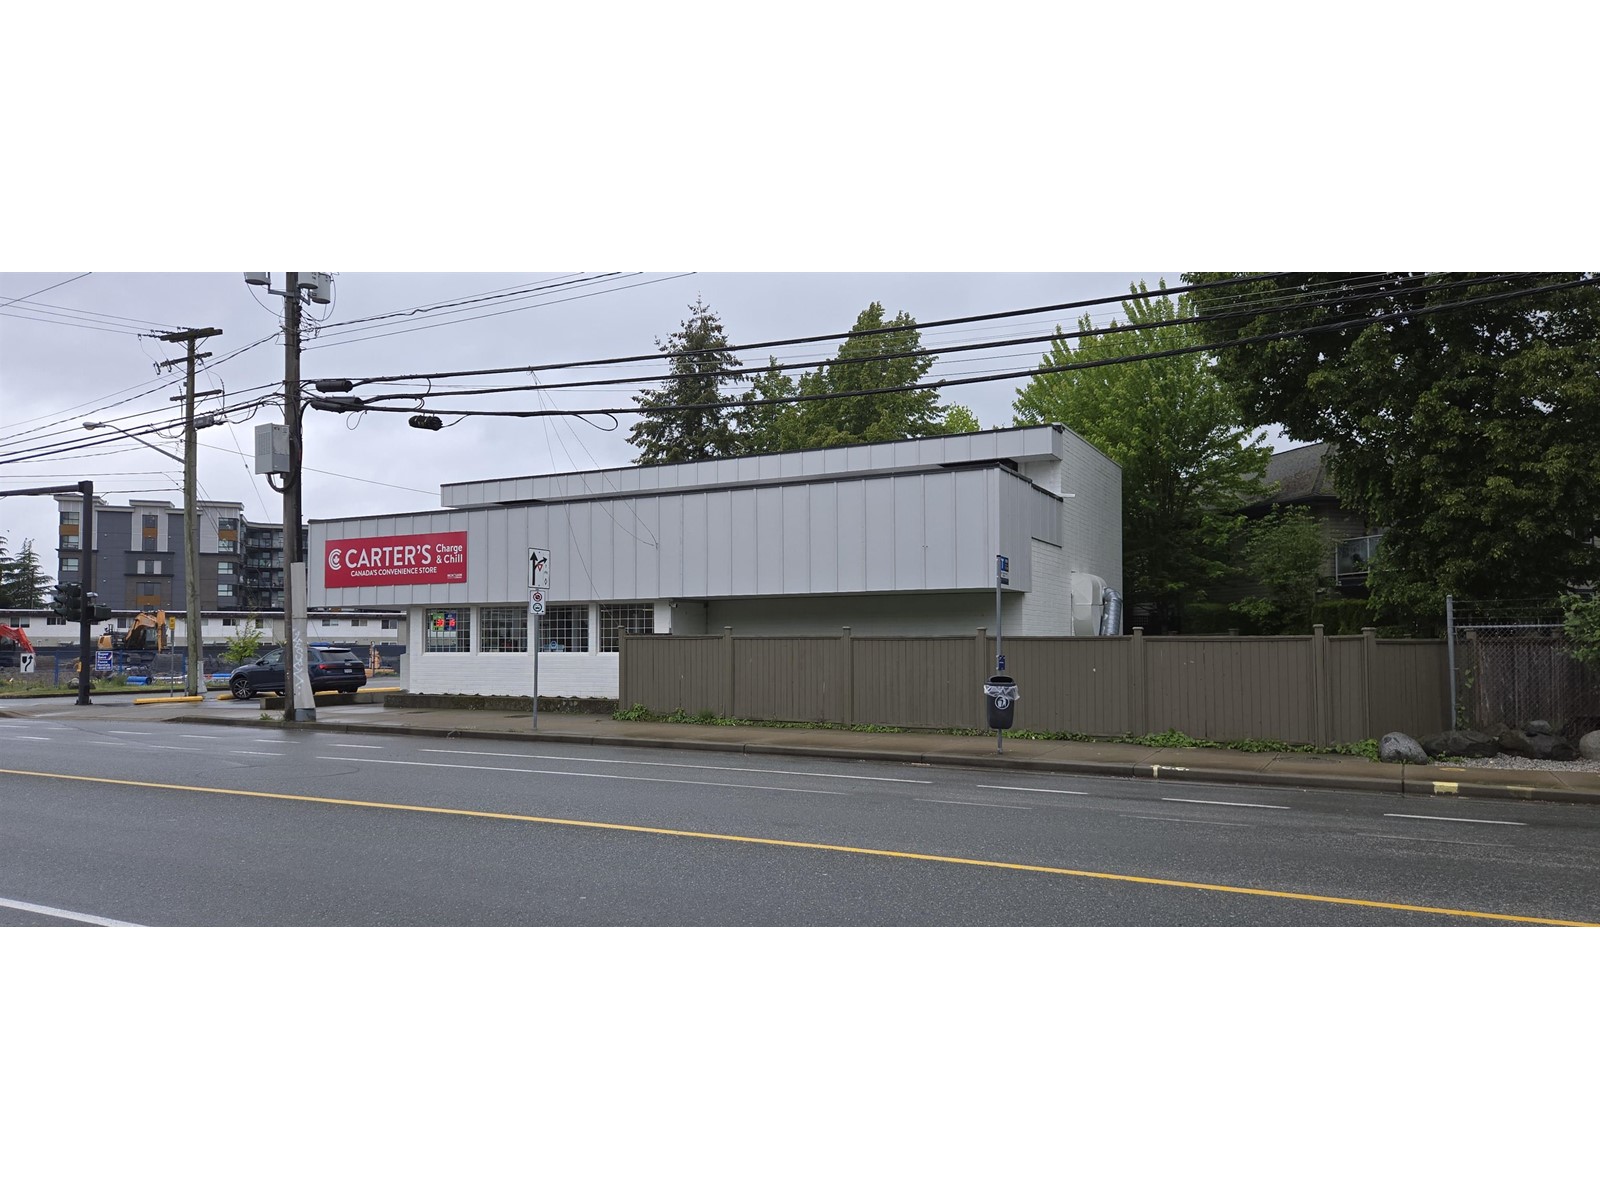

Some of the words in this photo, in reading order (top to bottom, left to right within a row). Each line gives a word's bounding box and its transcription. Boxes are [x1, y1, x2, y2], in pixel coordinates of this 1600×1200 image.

[435, 543, 463, 554] Charge
[345, 544, 432, 568] CARTER'S
[436, 555, 442, 564] &
[443, 554, 463, 564] Chill
[350, 569, 378, 577] CANADA'S
[378, 567, 418, 576] CONVENIENCE
